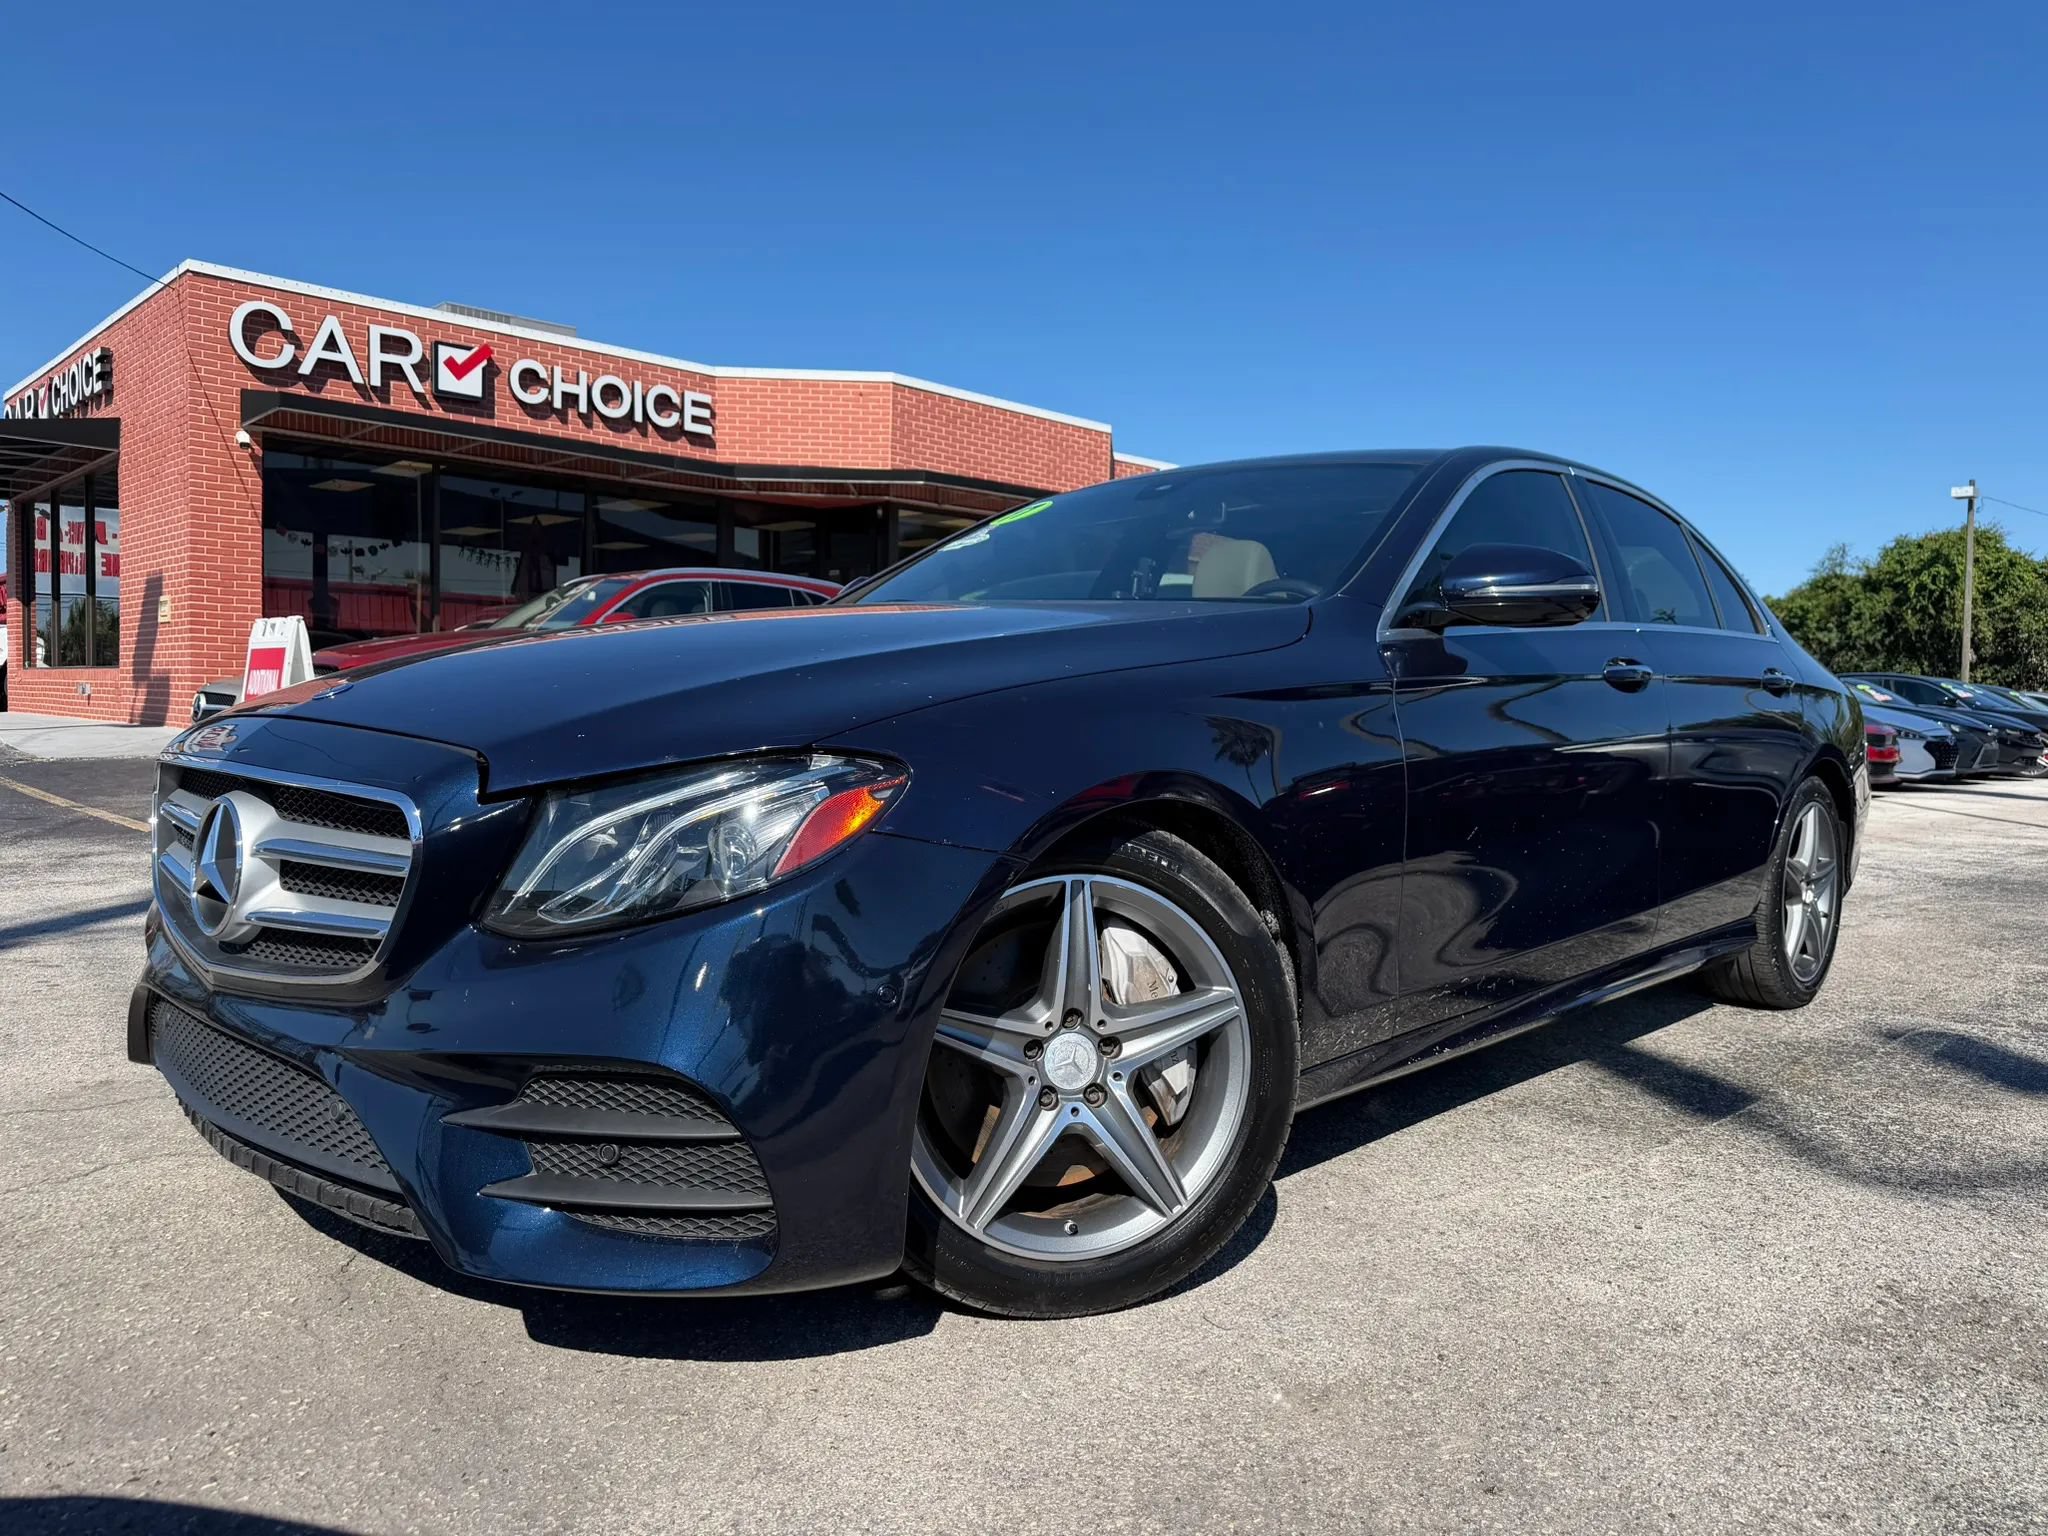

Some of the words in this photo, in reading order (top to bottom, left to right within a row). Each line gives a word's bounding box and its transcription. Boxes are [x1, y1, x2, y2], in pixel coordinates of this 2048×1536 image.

[51, 347, 103, 416] CHOICE
[229, 301, 425, 393] CAR
[509, 358, 713, 435] CHOICE
